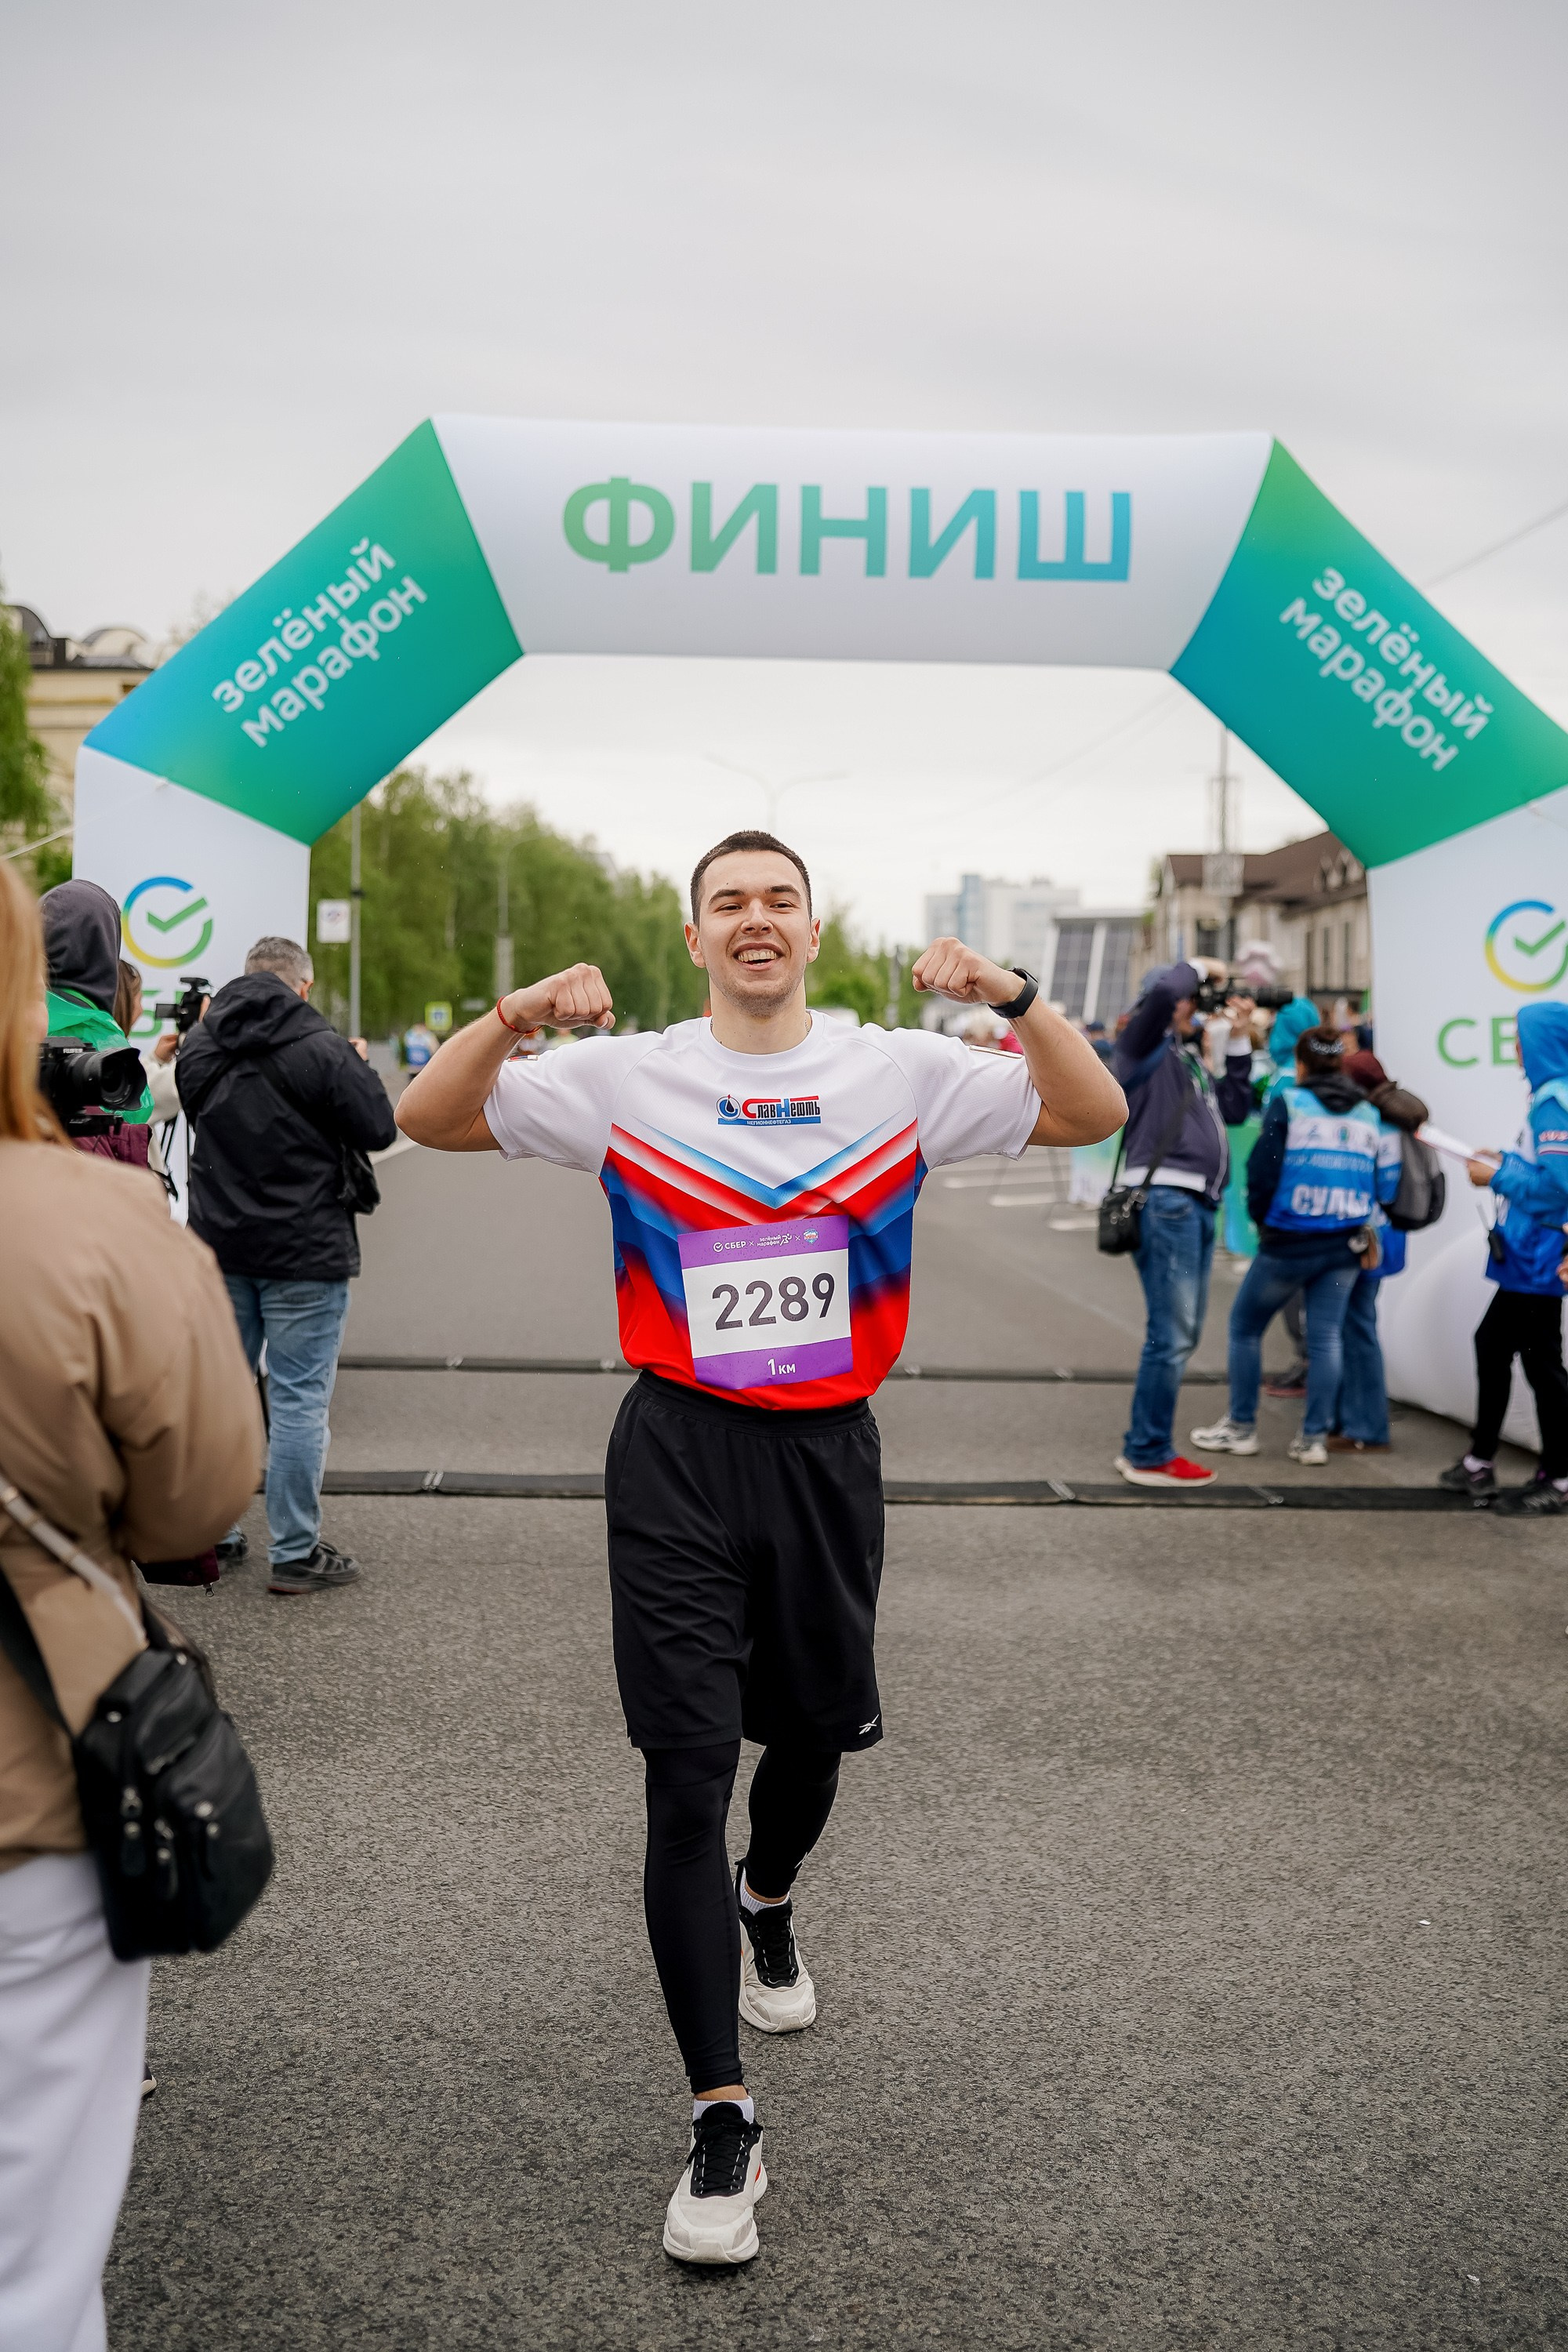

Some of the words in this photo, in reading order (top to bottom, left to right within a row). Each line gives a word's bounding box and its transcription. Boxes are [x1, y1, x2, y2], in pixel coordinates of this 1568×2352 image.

[562, 477, 1134, 583] ФИНИШ
[211, 536, 397, 713] зелёный
[241, 574, 427, 748] марафон
[1279, 597, 1459, 771] марафон
[1312, 566, 1494, 740] зелёный
[712, 1272, 835, 1330] 2289
[724, 1240, 746, 1250] СБЕР
